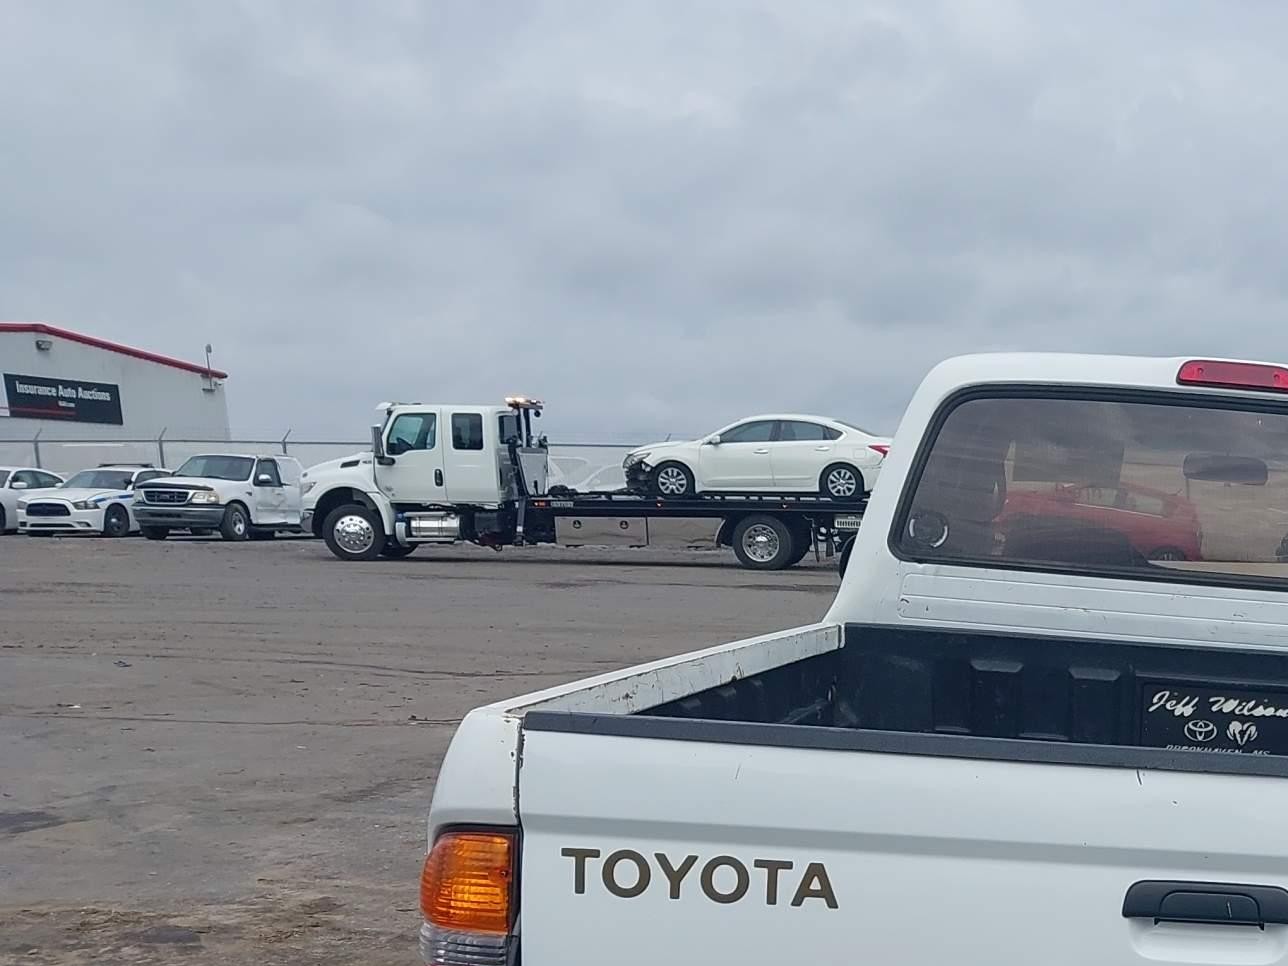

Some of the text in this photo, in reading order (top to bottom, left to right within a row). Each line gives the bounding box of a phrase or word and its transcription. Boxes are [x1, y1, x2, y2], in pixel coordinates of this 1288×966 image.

[15, 380, 111, 401] Insurance Auto Auctions
[1148, 690, 1200, 717] Jeff
[561, 847, 839, 910] TOYOTA
